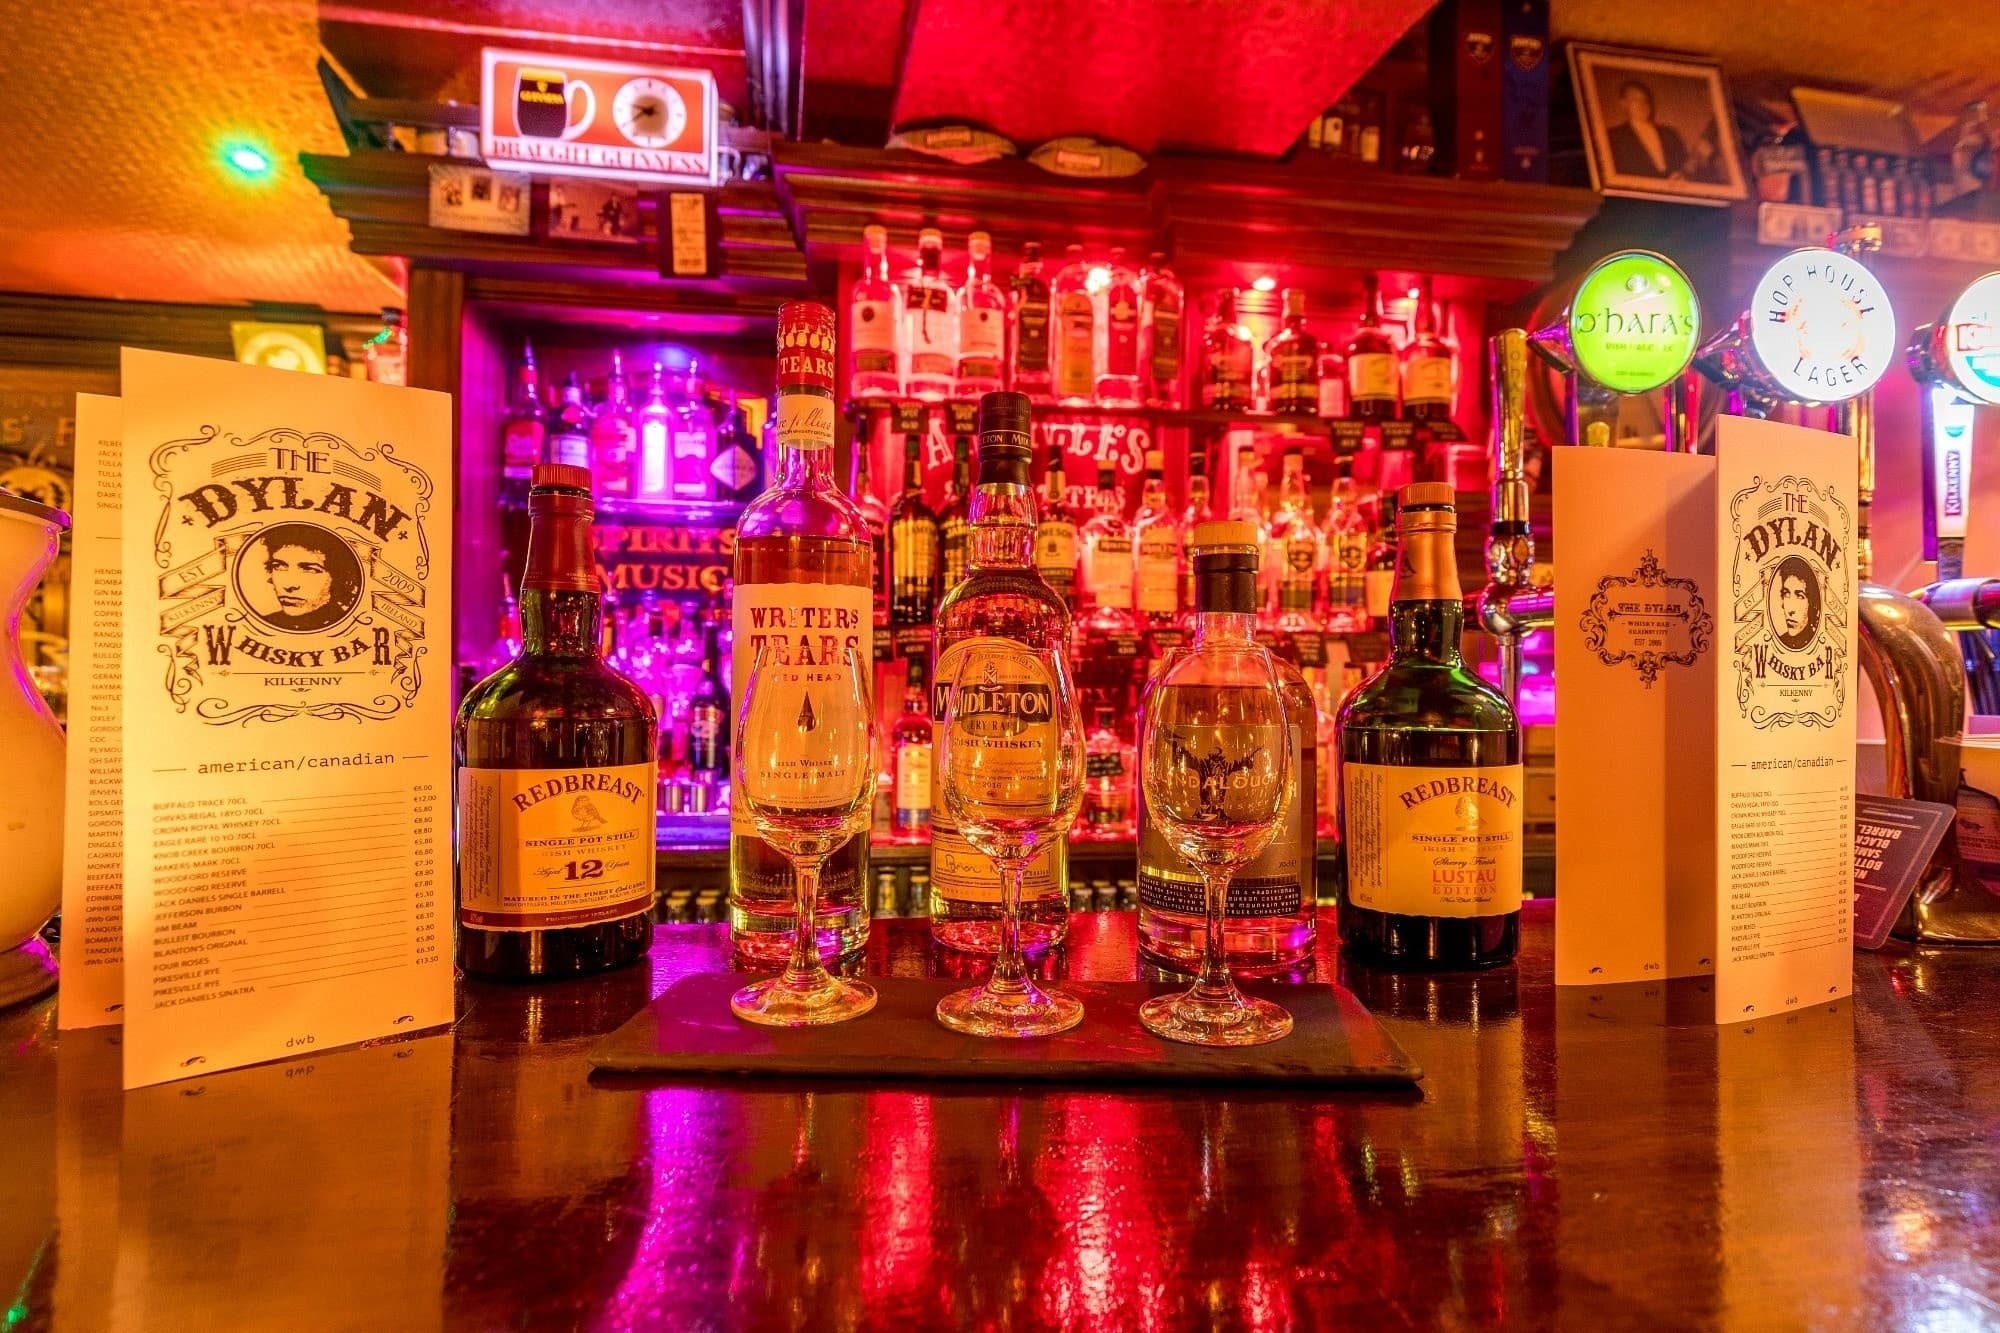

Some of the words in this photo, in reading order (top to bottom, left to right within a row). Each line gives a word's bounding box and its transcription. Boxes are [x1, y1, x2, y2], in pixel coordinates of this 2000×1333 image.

[1769, 274, 1796, 323] HOP
[780, 355, 833, 379] TEARS
[1793, 355, 1869, 387] LAGER
[268, 447, 331, 474] THE
[178, 476, 412, 542] DYLAN
[1782, 492, 1809, 514] THE
[1743, 516, 1842, 571] DYLAN
[178, 564, 206, 584] EST
[381, 571, 415, 595] 2009
[203, 624, 325, 668] WHISKY
[331, 626, 392, 666] BAR
[750, 634, 859, 667] TEARS
[1754, 644, 1807, 681] WHISKY
[1808, 645, 1834, 679] BAR
[263, 676, 342, 686] KILKENNY
[806, 673, 842, 682] HEAD
[1779, 688, 1813, 697] KILKENNY
[198, 752, 395, 774] american/canadian
[1751, 755, 1834, 770] american/canadian
[760, 771, 809, 780] SINGLE
[816, 769, 847, 779] MALT
[512, 773, 643, 812] REDBREAST
[1400, 776, 1516, 810] REDBREAST
[525, 839, 575, 847] SINGLE
[580, 836, 603, 844] POT
[606, 831, 635, 841] STILL
[1411, 834, 1457, 843] SINGLE
[1462, 835, 1481, 843] POT
[1485, 833, 1510, 842] STILL
[1855, 835, 1891, 849] BLACK
[564, 859, 604, 881] 12
[1431, 868, 1497, 884] LUSTAU
[563, 893, 581, 901] THE
[1431, 885, 1497, 896] EDITION
[286, 1034, 315, 1048] dwb
